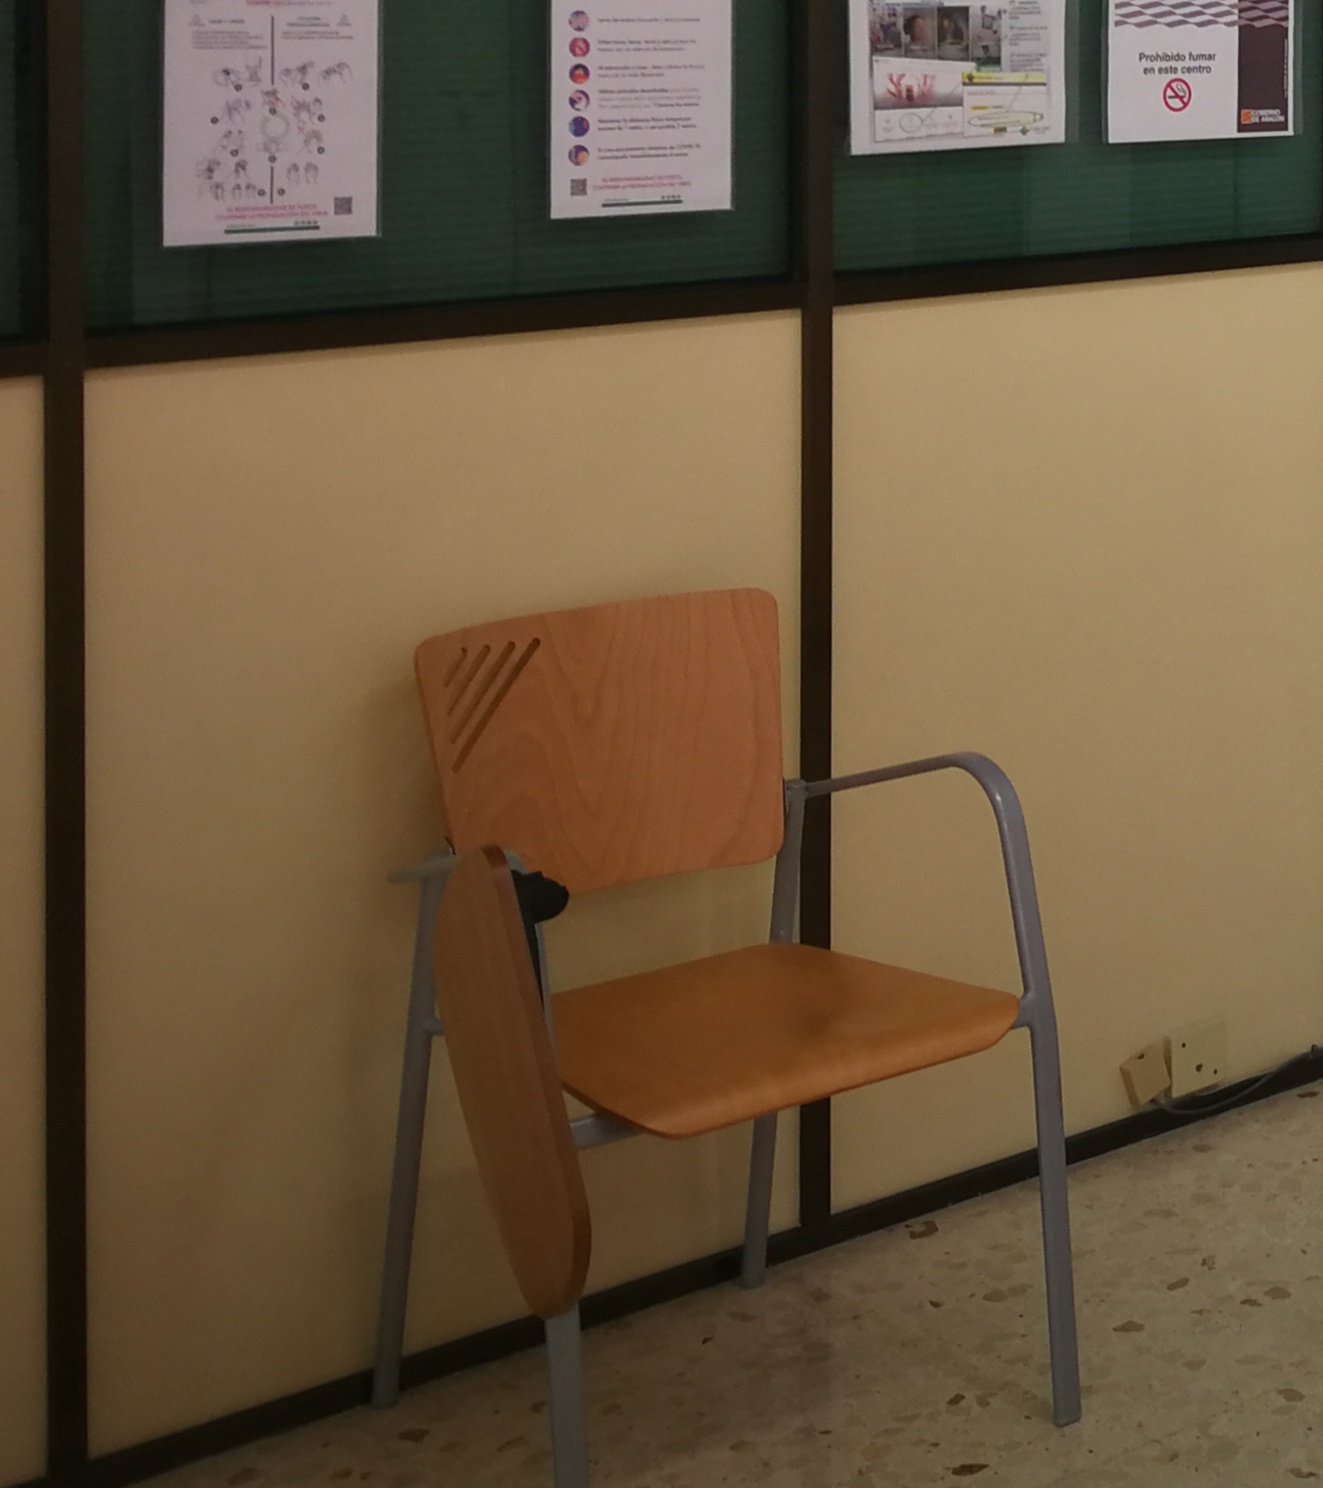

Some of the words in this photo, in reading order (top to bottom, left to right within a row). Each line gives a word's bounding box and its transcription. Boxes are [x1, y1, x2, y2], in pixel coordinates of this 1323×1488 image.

[1138, 52, 1187, 63] Prohibido
[1188, 52, 1217, 63] fumar
[1143, 67, 1156, 75] en
[1157, 65, 1179, 75] este
[1180, 64, 1212, 74] centro
